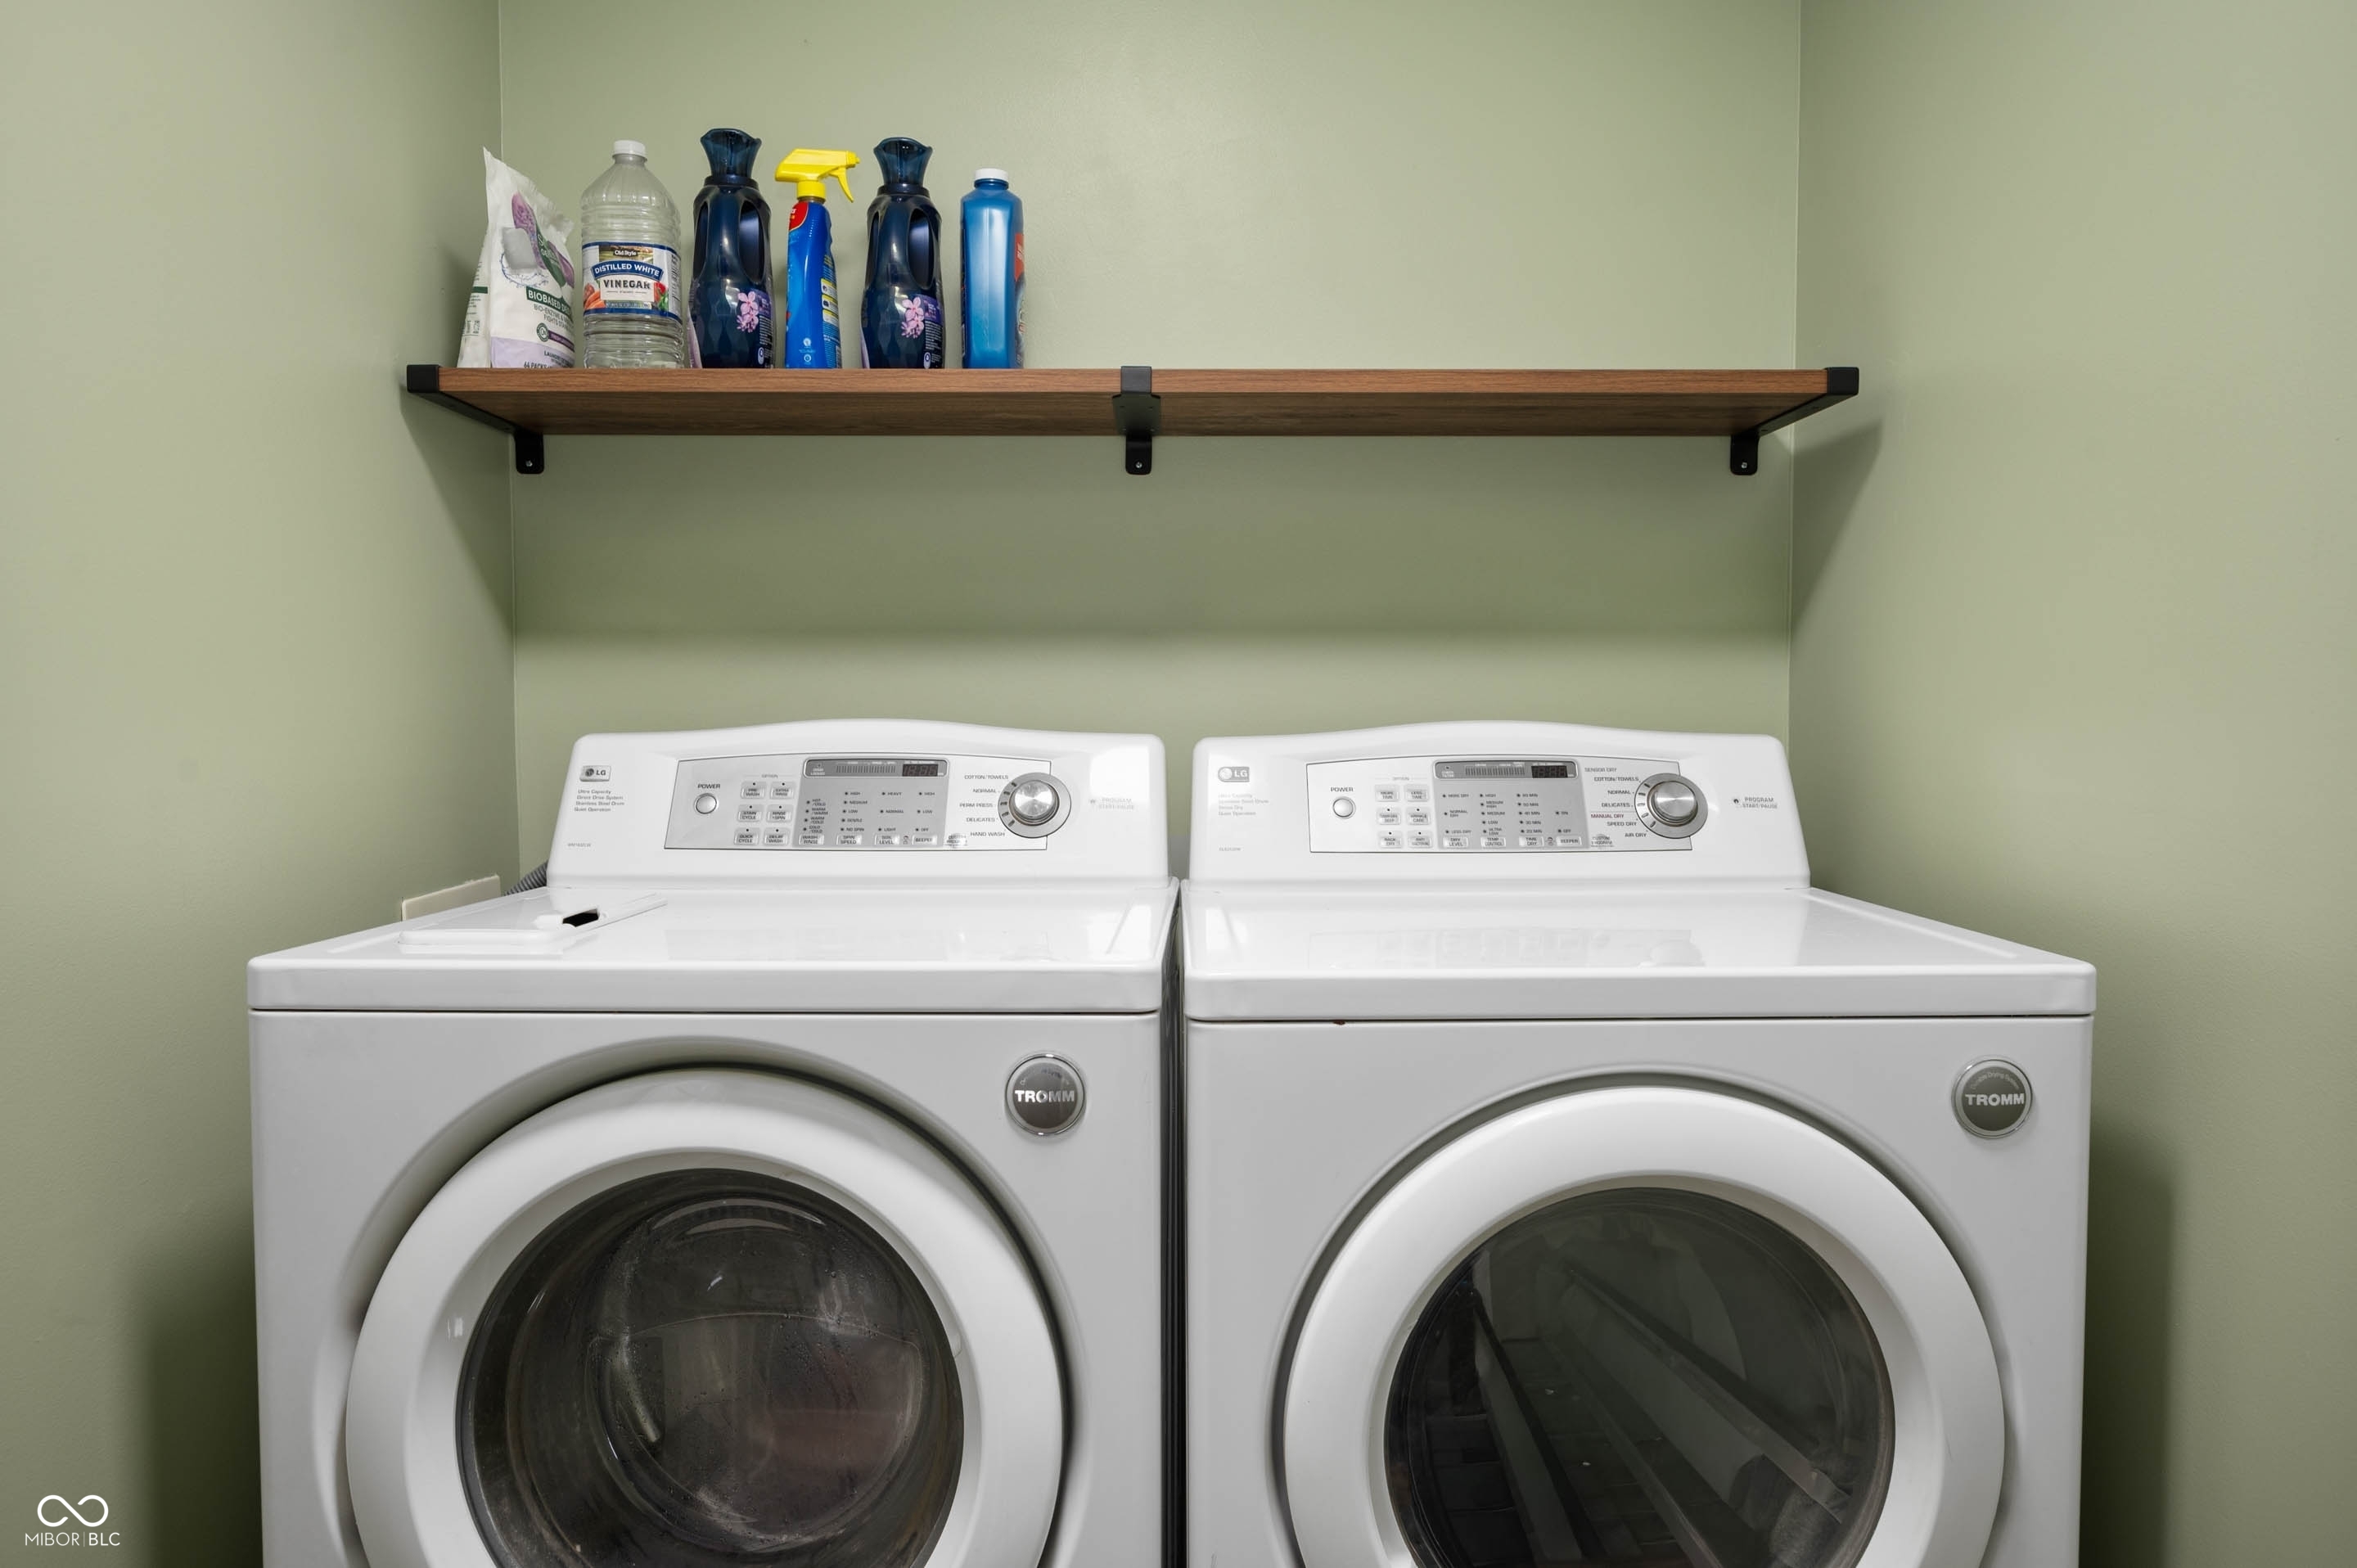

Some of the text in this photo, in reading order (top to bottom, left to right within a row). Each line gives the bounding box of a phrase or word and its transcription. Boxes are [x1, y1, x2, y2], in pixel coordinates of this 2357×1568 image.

[595, 264, 659, 276] DISTILLED WHITE
[604, 279, 651, 289] VINEGAR
[528, 290, 561, 309] BIOBASED
[1015, 1090, 1074, 1103] TROMM
[1965, 1093, 2024, 1106] TROMM
